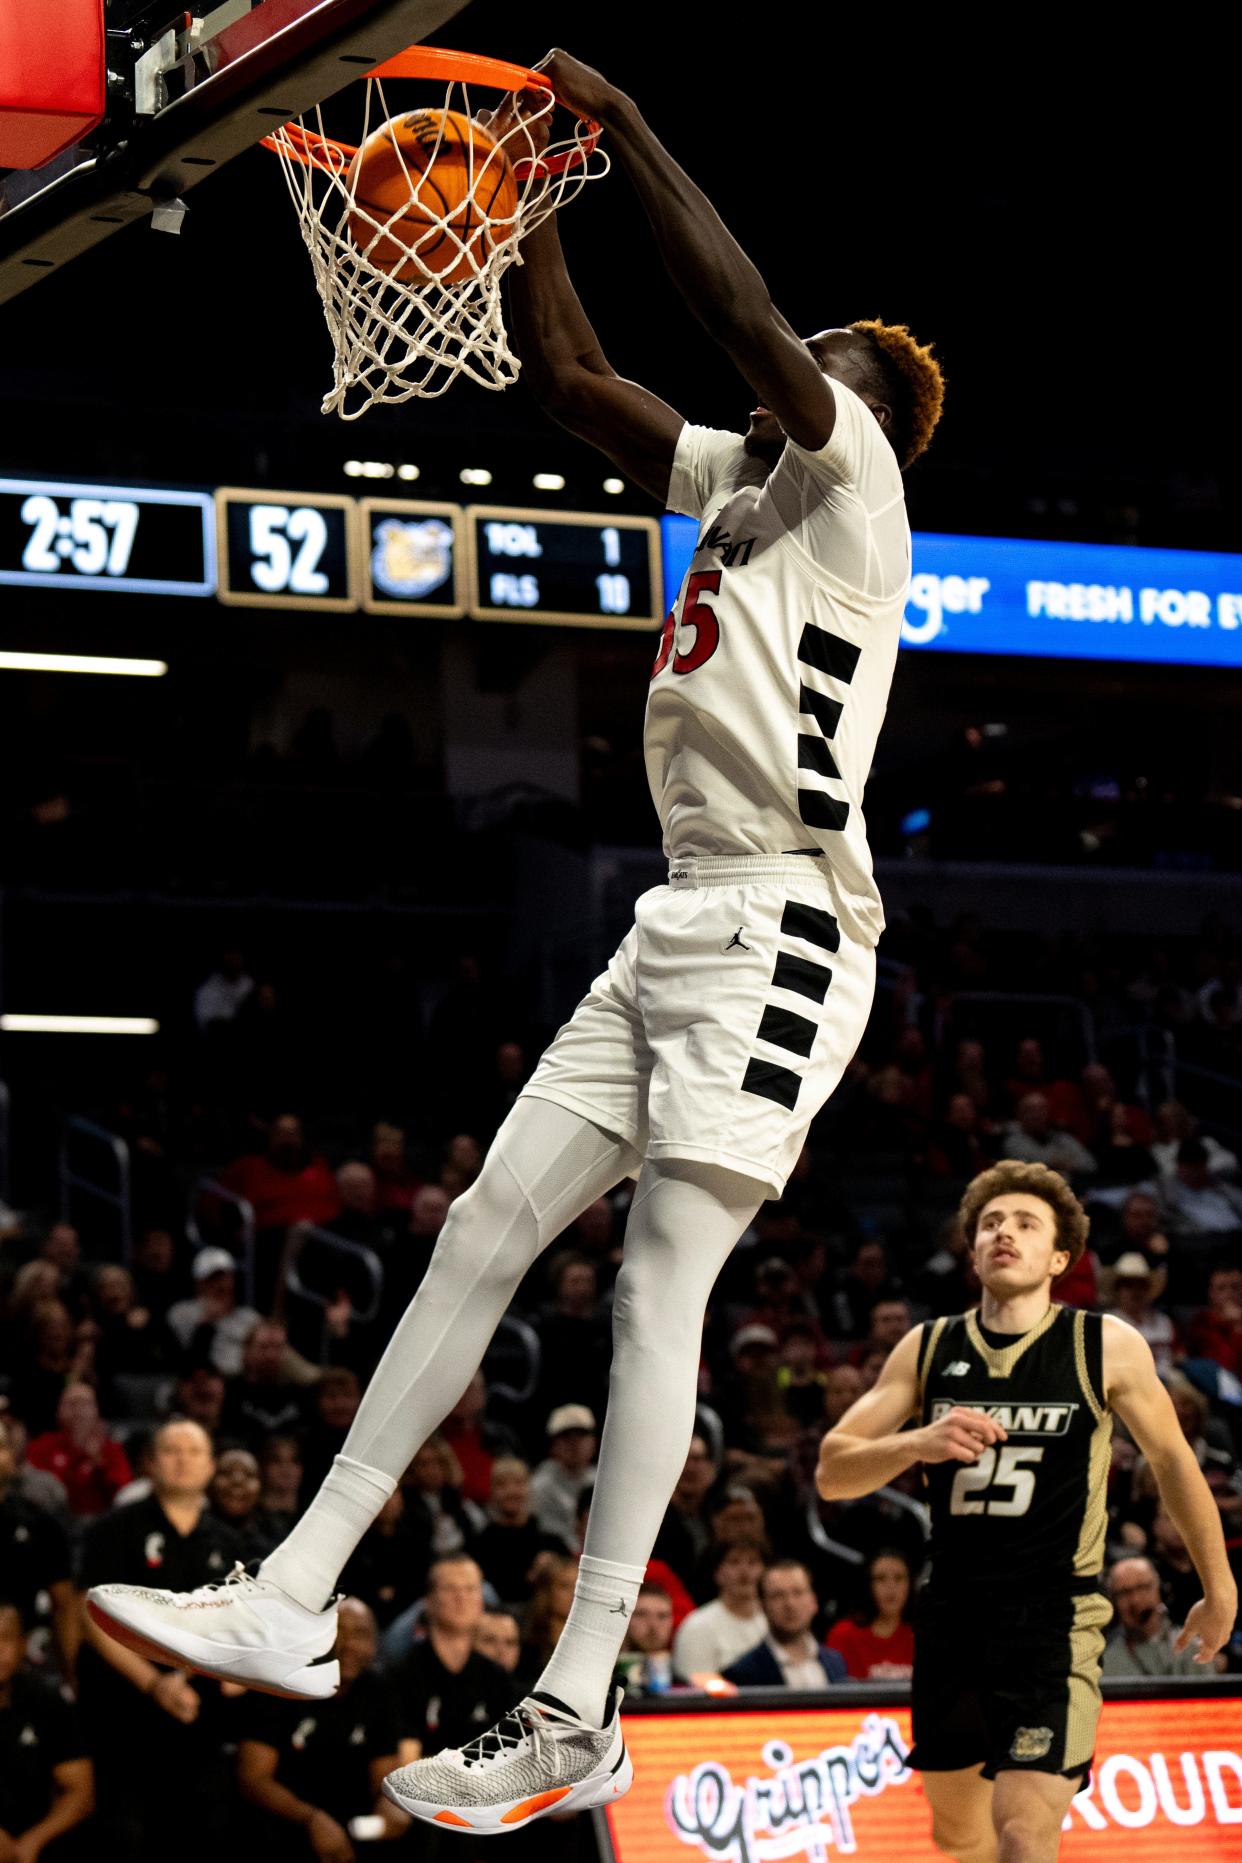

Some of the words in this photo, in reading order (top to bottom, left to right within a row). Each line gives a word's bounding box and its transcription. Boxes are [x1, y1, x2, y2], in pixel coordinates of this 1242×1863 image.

[21, 496, 140, 576] 2:57
[251, 505, 329, 594] 52
[485, 522, 543, 558] TOL
[601, 527, 621, 567] 1
[490, 573, 540, 607] FLS
[1027, 580, 1133, 624] FRESH
[1139, 587, 1211, 628] FOR
[932, 1402, 1068, 1432] BYANT
[950, 1446, 1044, 1517] 25
[664, 1713, 912, 1863] Grippo's
